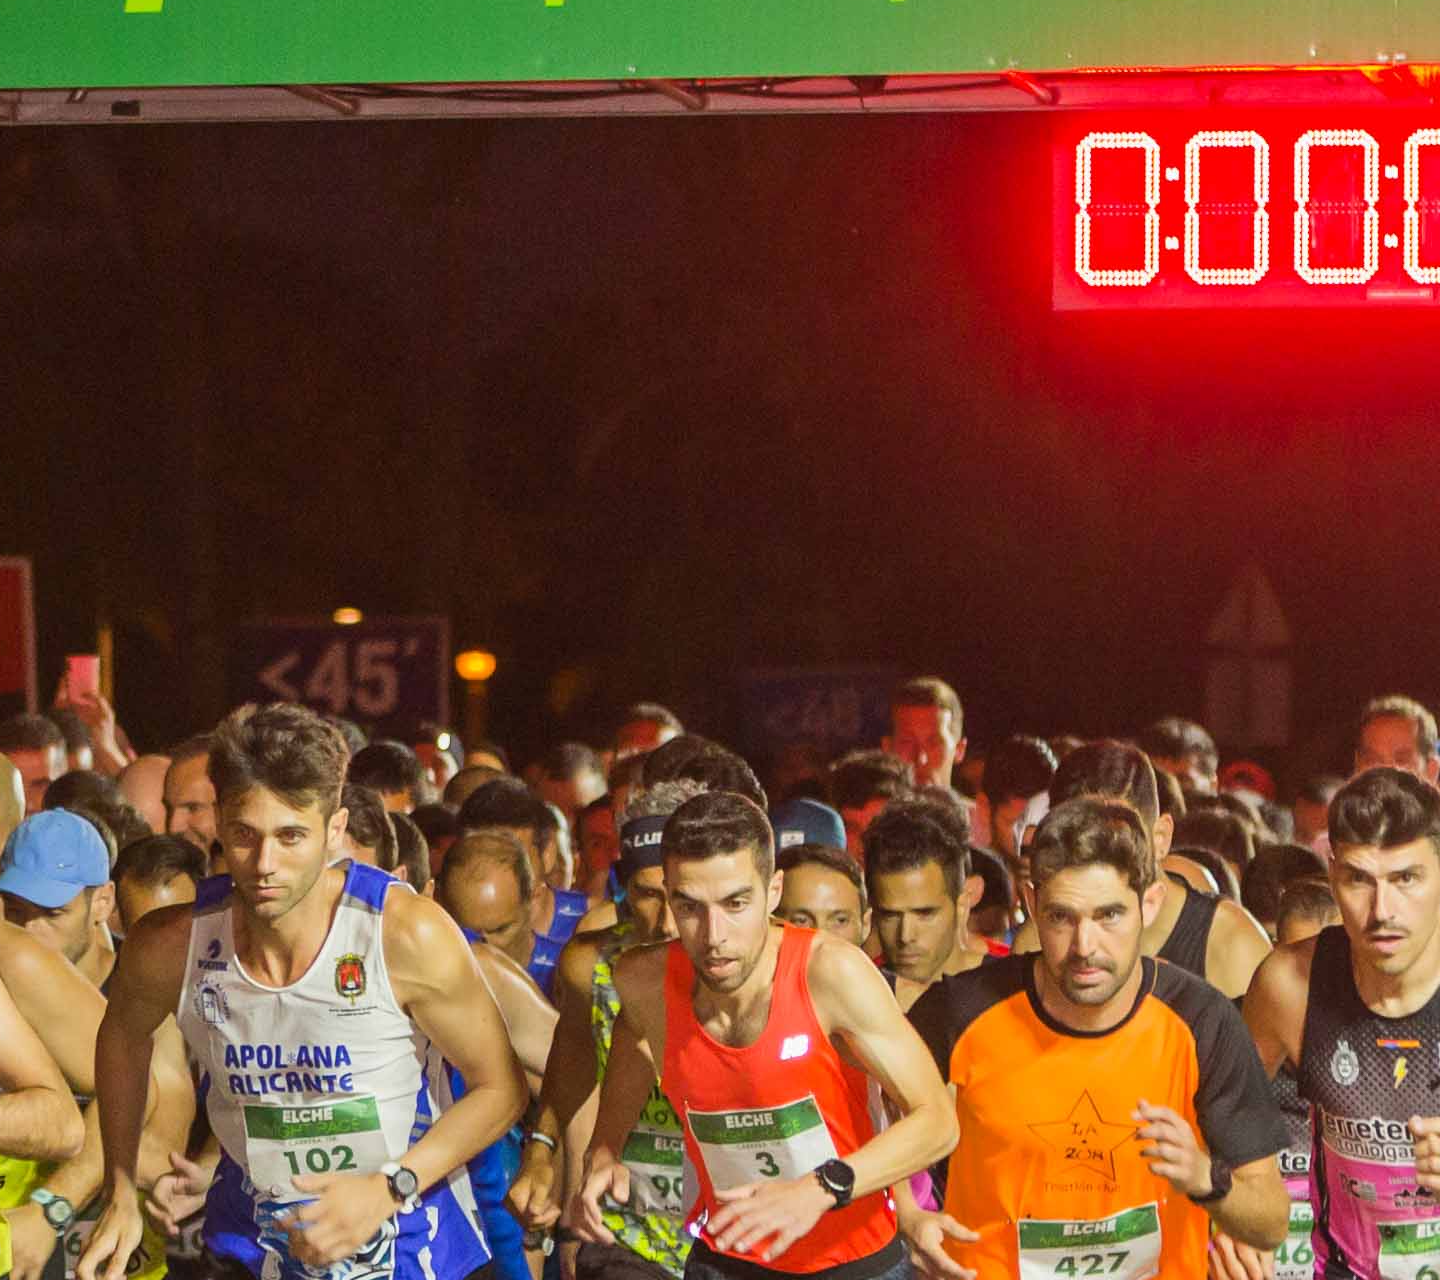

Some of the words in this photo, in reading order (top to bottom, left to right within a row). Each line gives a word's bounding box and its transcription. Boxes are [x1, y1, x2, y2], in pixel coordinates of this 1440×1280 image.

[228, 1070, 354, 1096] ALICANTE
[282, 1107, 334, 1124] ELCHE
[724, 1112, 774, 1129] ELCHE
[283, 1145, 357, 1176] 102
[754, 1151, 781, 1178] 3
[1063, 1219, 1117, 1237] ELCHE
[1054, 1249, 1131, 1278] 427
